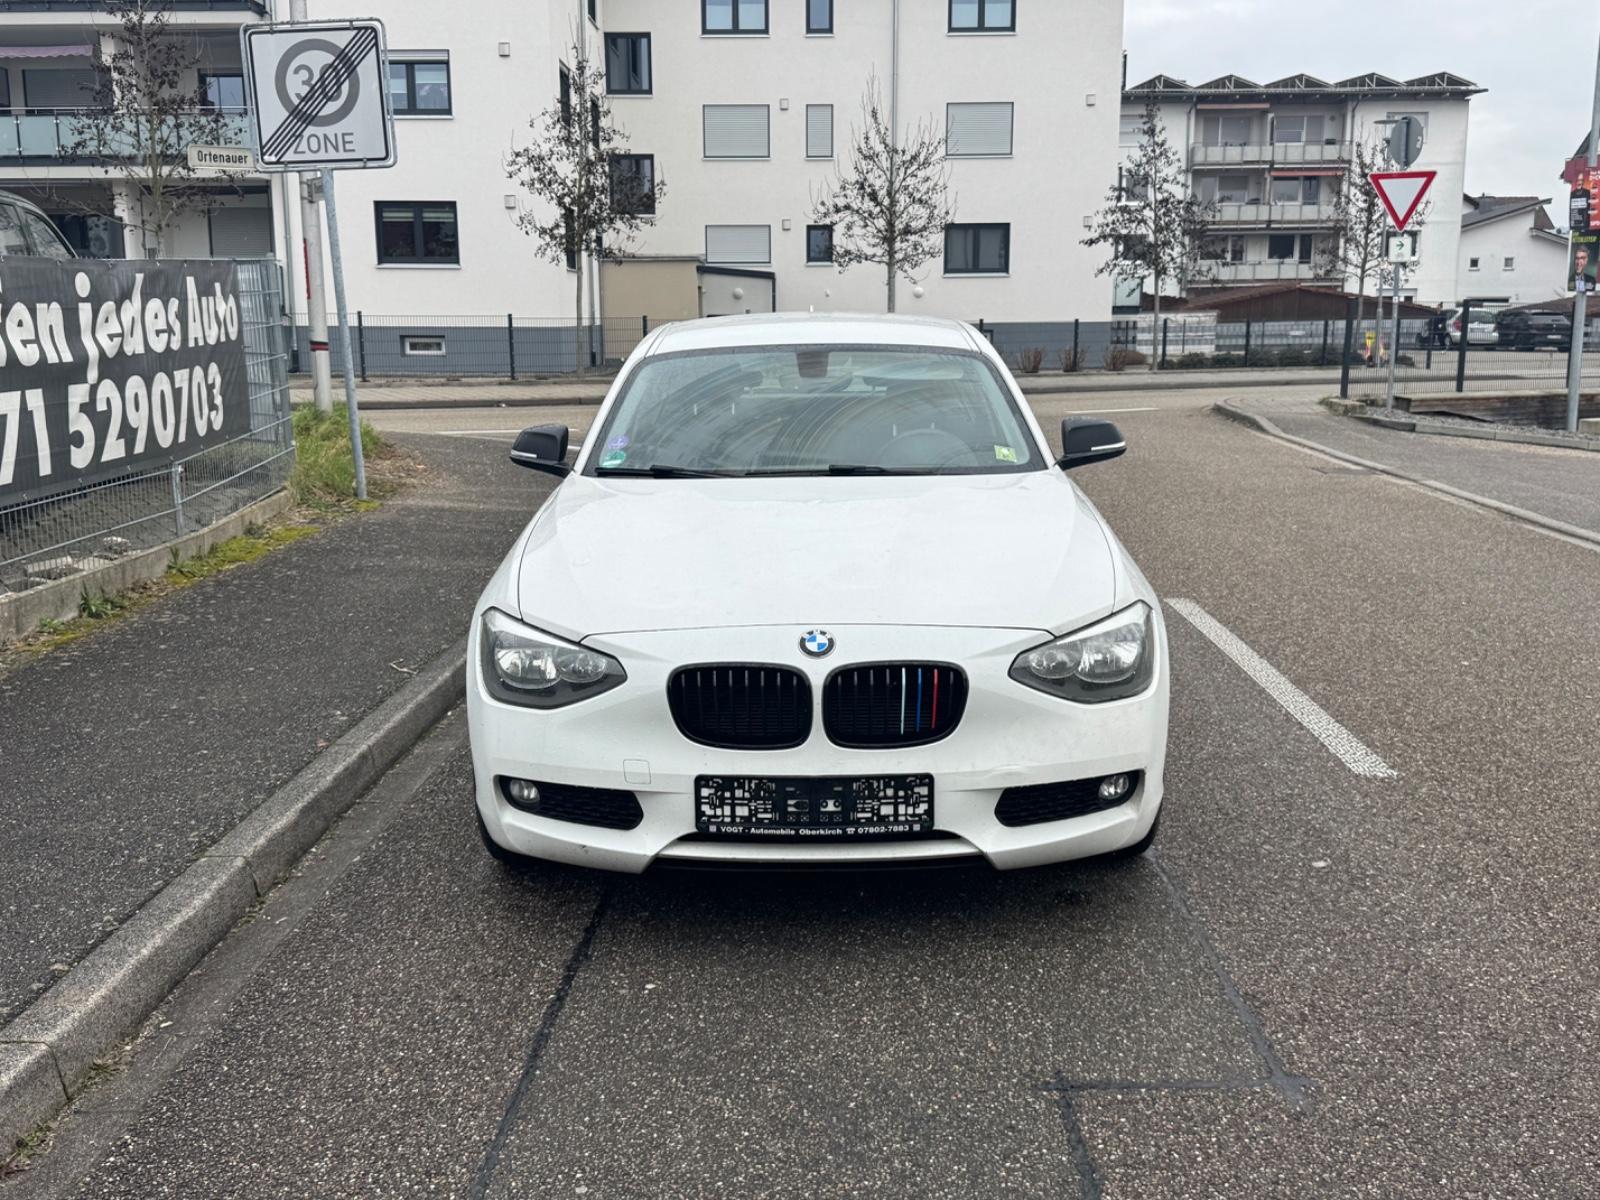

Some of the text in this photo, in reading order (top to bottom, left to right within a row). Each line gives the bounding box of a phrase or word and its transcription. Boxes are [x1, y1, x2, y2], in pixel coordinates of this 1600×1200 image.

[292, 63, 343, 102] 30
[197, 150, 248, 164] Ortenauer
[292, 132, 356, 154] ZONE
[0, 271, 239, 385] en jedes Auto
[67, 361, 224, 470] 5290703
[720, 826, 744, 834] VOGT
[750, 827, 796, 836] Automobile
[799, 827, 842, 836] Oberkirch
